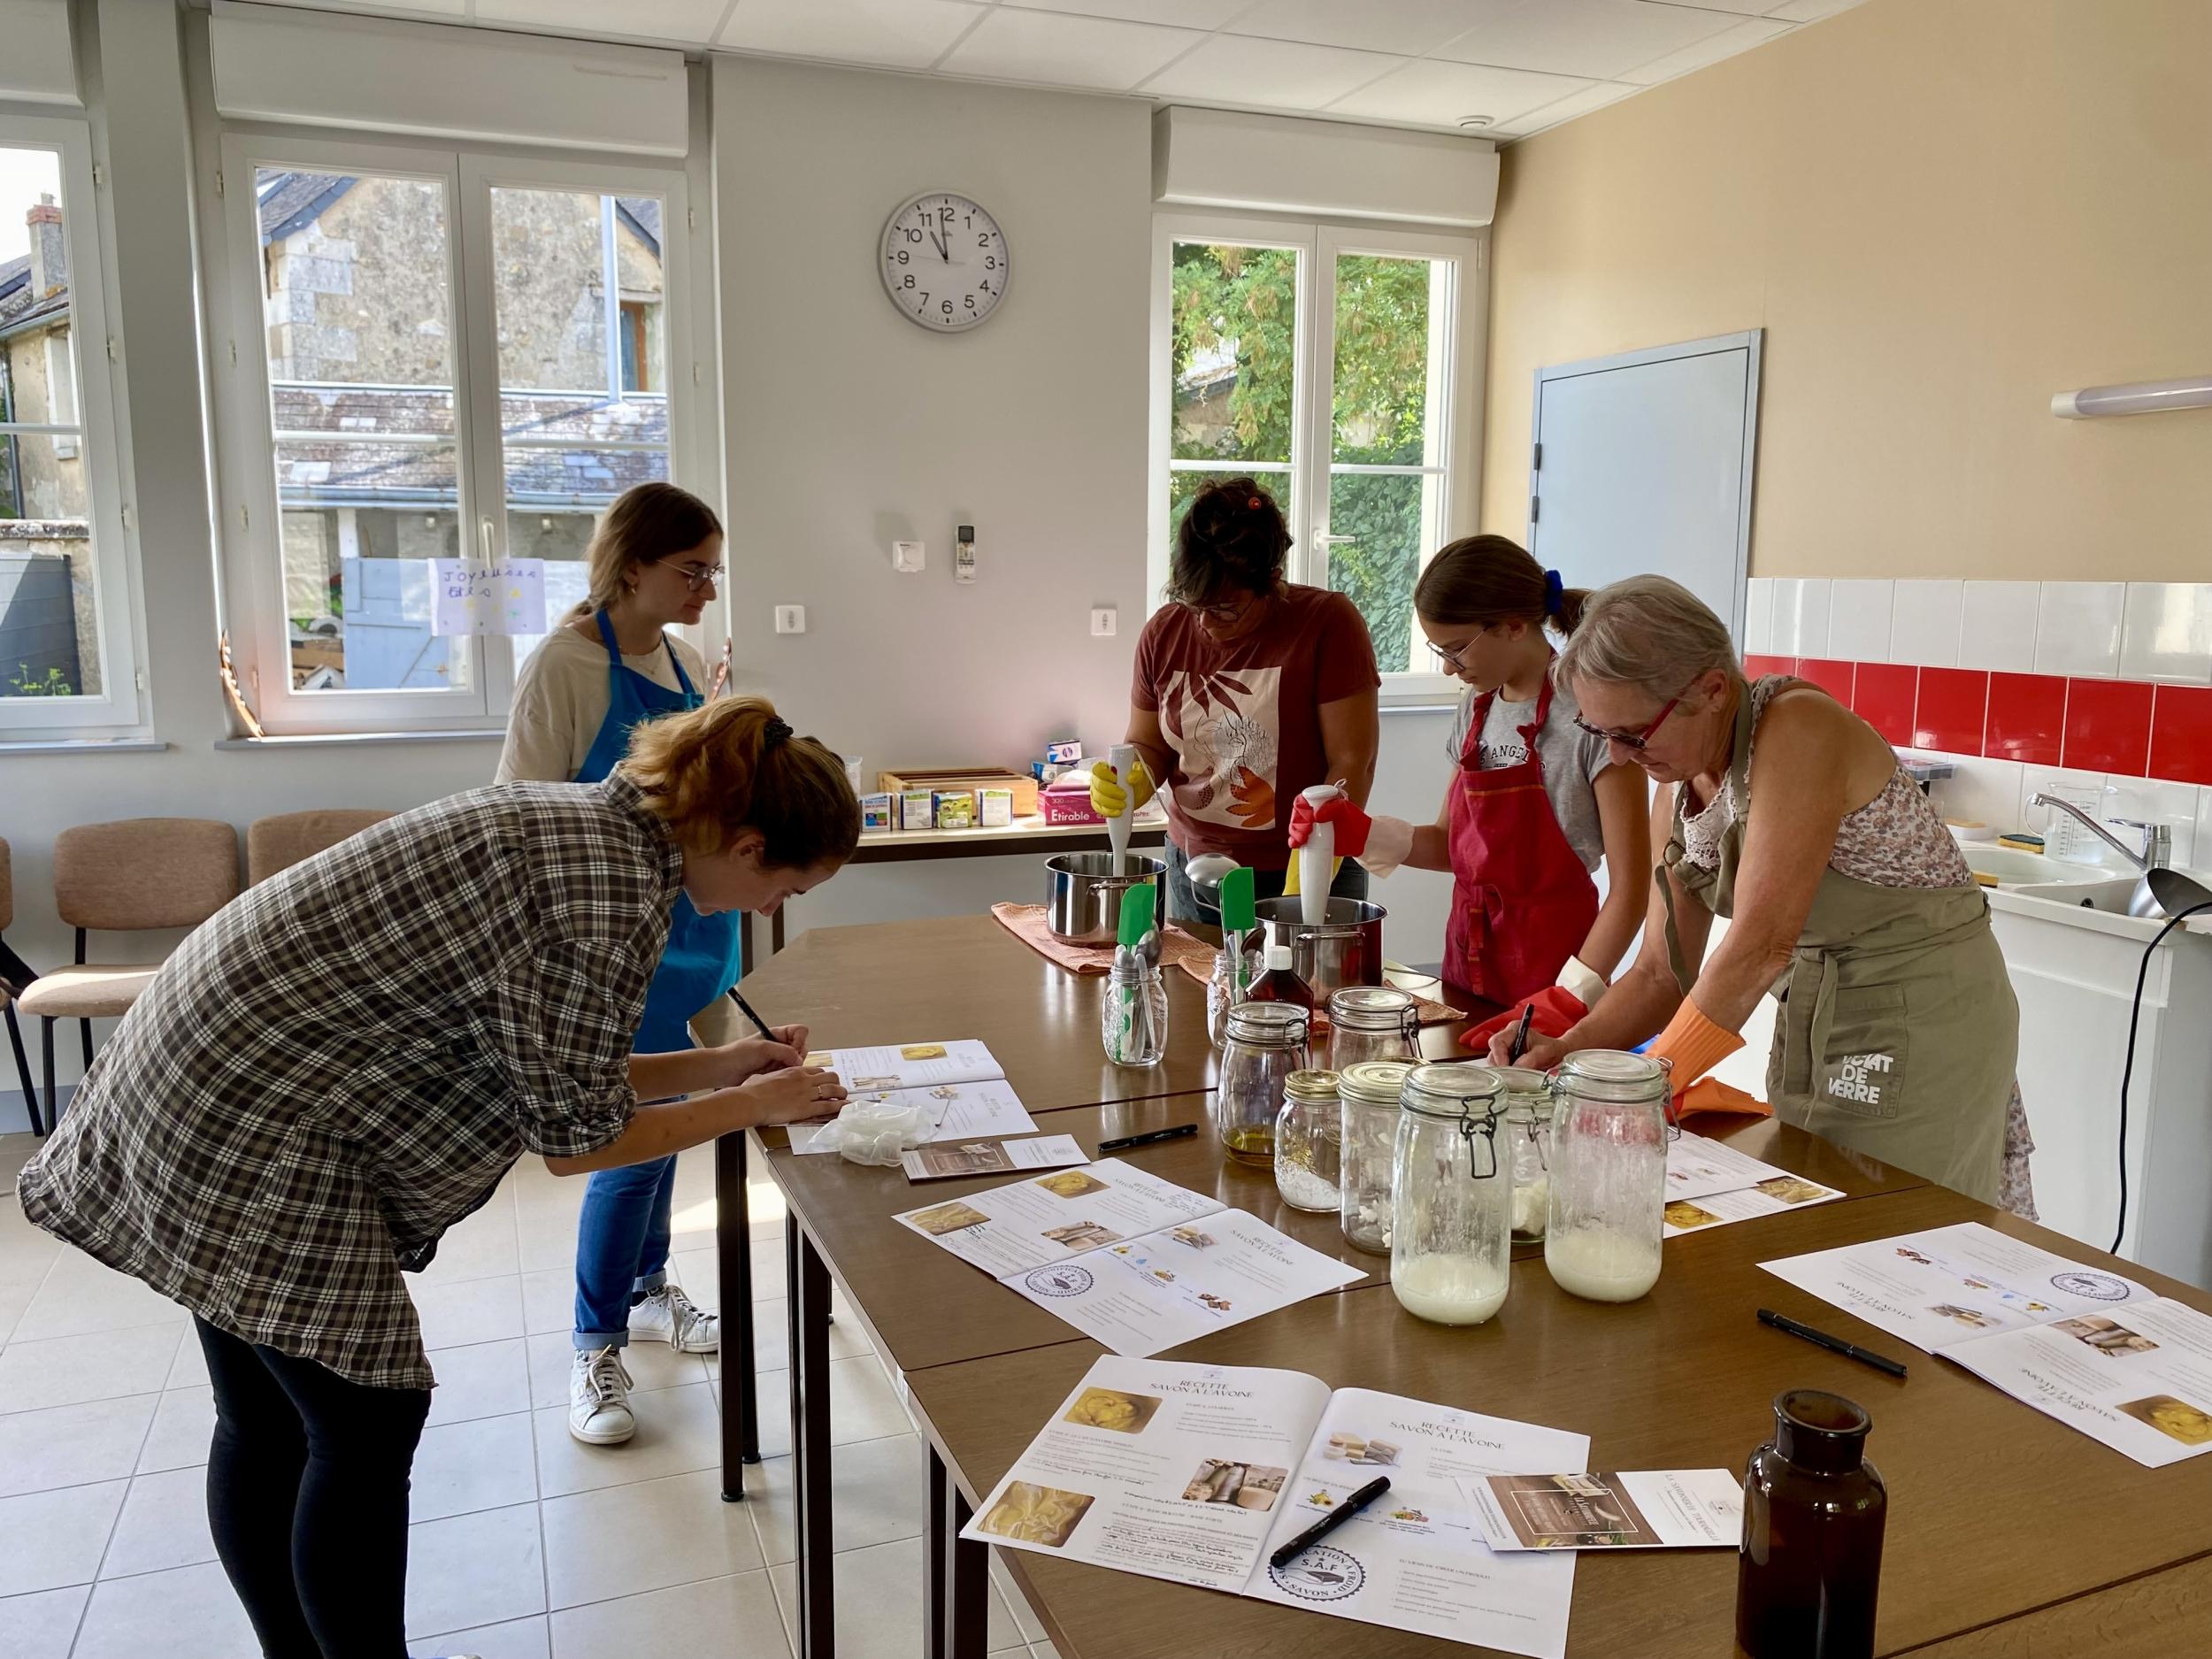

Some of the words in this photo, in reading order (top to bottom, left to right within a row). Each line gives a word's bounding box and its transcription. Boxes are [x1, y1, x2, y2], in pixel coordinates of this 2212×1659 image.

[918, 213, 932, 227] 11
[938, 207, 955, 221] 12
[964, 216, 972, 229] 1
[903, 228, 923, 242] 10
[978, 233, 989, 247] 2
[897, 250, 910, 265] 9
[985, 256, 995, 269] 3
[903, 274, 915, 288] 8
[979, 280, 990, 292] 4
[919, 292, 930, 305] 7
[964, 295, 975, 308] 5
[941, 300, 953, 314] 6
[1051, 809, 1090, 822] Etirable
[1841, 1064, 1868, 1084] DE
[1828, 1077, 1881, 1104] VERRE
[1148, 1383, 1188, 1393] SAVON
[1179, 1380, 1228, 1389] RECETTE
[1389, 1421, 1433, 1436] SAVON
[1449, 1433, 1507, 1450] L'AVOINE
[1421, 1422, 1475, 1438] RECETTE
[1301, 1558, 1338, 1571] S.A.F
[1337, 1571, 1356, 1592] FROID
[1289, 1584, 1329, 1596] SAVON
